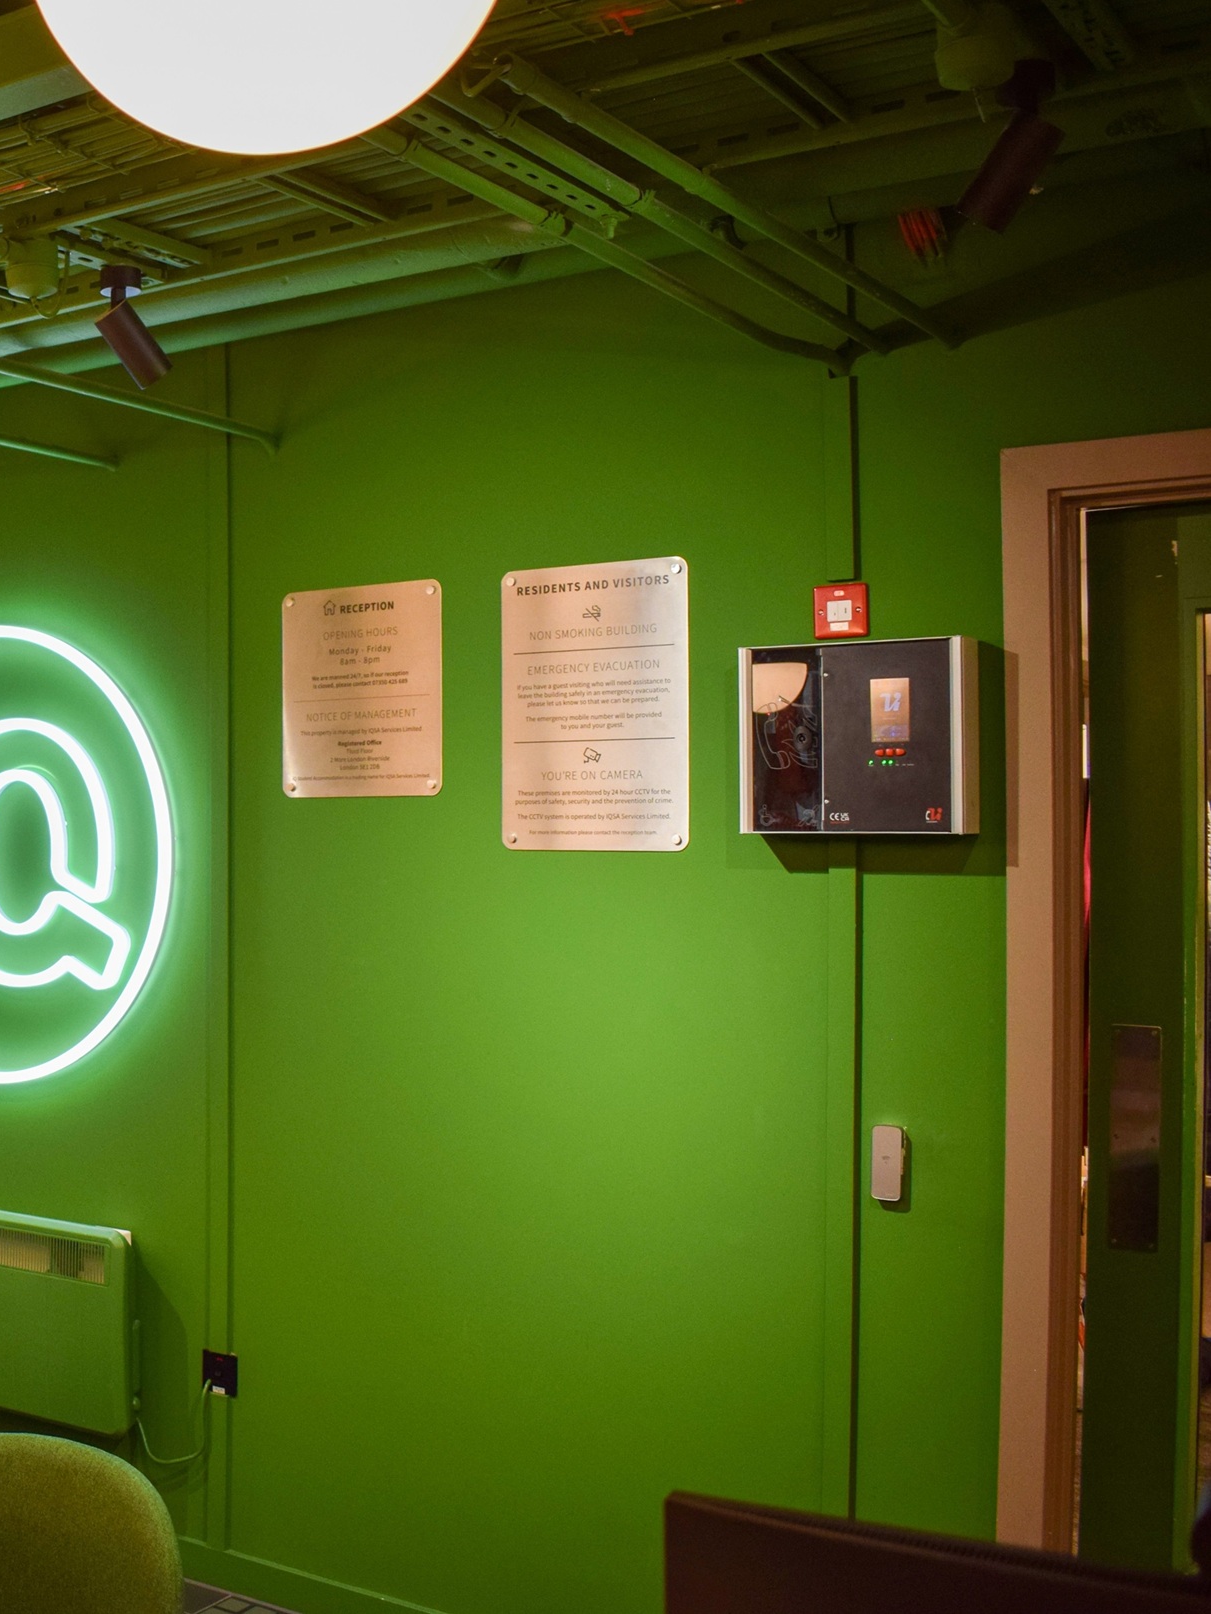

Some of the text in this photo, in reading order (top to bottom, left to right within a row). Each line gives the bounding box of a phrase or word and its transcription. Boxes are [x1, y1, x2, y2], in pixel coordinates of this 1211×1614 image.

[517, 575, 669, 596] RESIDENTS AND VISITORS
[340, 601, 394, 614] RECEPTION
[323, 627, 398, 640] OPENING HOURS
[530, 624, 657, 640] NON SMOKING BUILDING
[329, 647, 359, 655] Monday
[340, 656, 356, 665] 8am
[528, 660, 660, 675] EMERGENCY EVACUATION
[307, 708, 416, 722] NOTICE OF MANAGEMENT
[581, 770, 596, 780] ON
[600, 770, 643, 780] CAMERA
